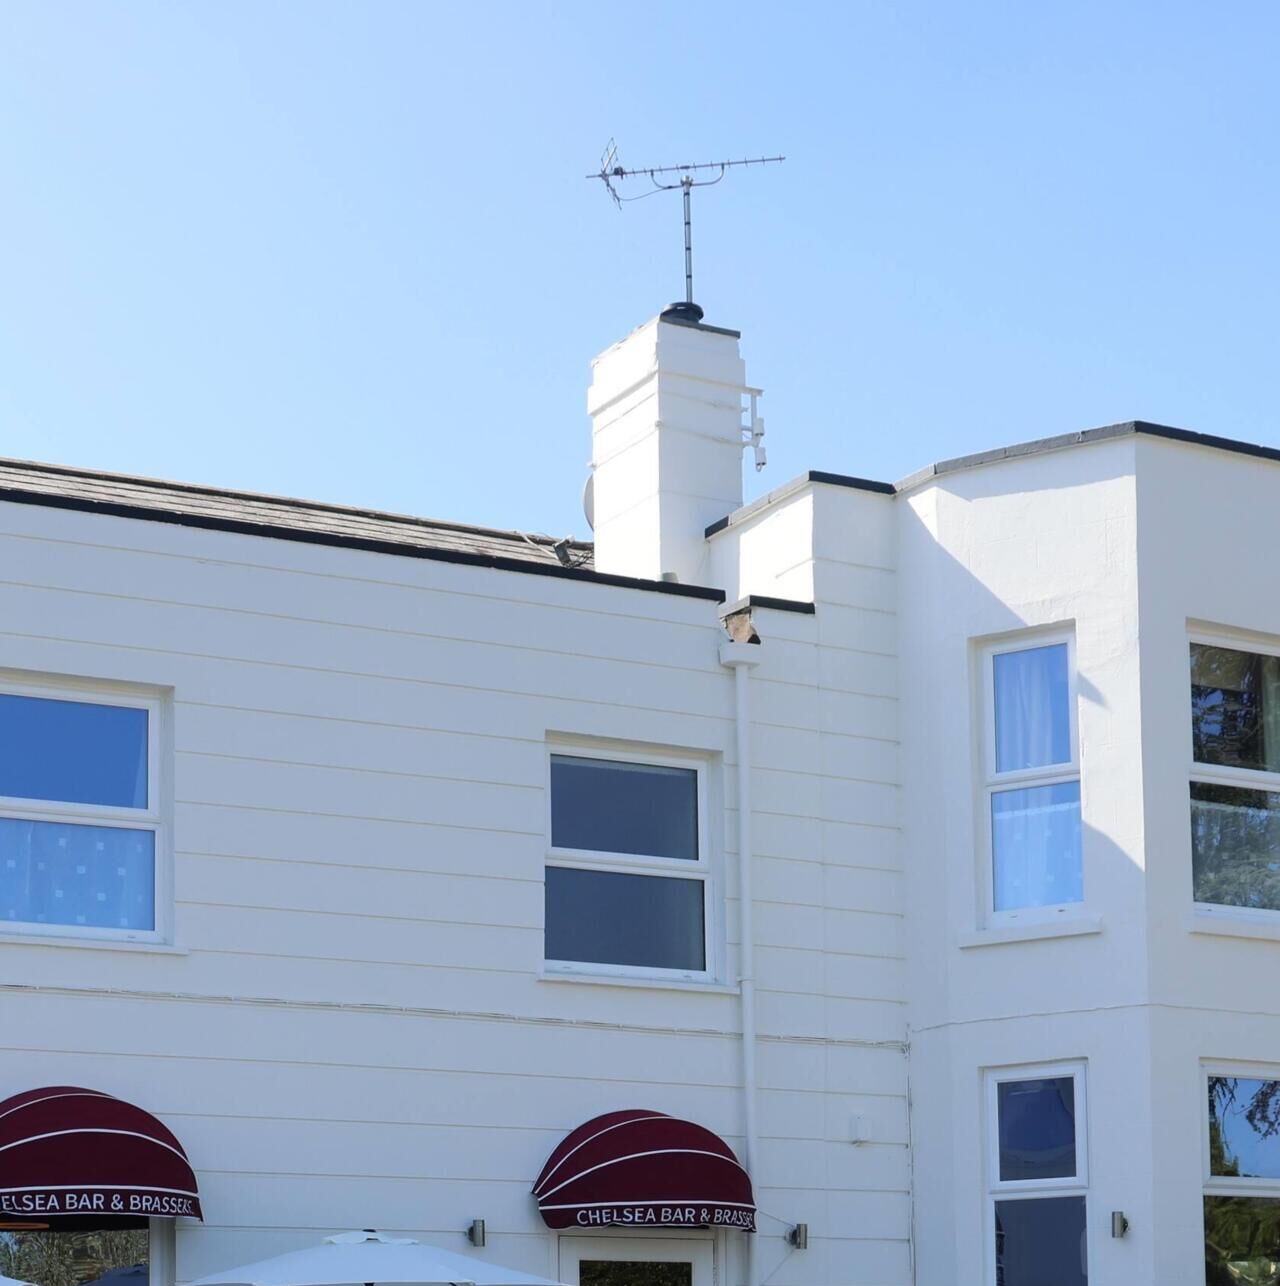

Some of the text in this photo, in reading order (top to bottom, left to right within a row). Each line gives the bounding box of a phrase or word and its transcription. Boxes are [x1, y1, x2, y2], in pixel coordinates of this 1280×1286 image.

[65, 1193, 105, 1210] BAR
[112, 1194, 124, 1211] &
[576, 1207, 656, 1225] CHELSEA
[660, 1207, 695, 1222] BAR
[700, 1208, 711, 1222] &
